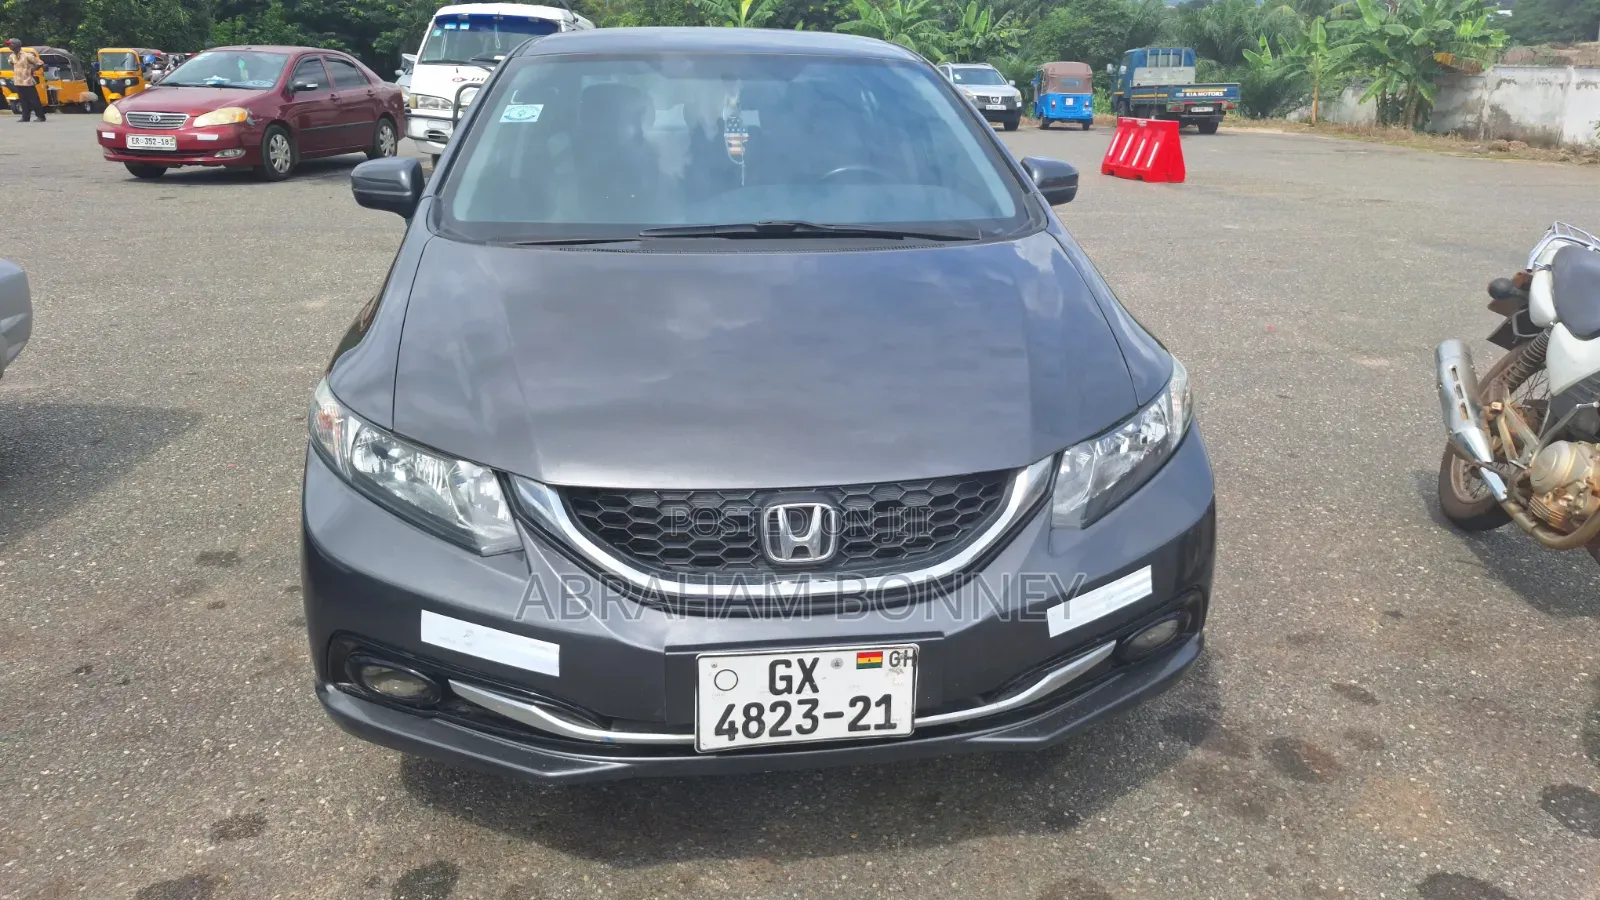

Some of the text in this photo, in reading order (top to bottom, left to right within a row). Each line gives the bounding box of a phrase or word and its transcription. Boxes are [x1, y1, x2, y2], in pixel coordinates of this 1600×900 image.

[768, 650, 918, 696] GX GH
[714, 693, 897, 741] 4823-21
